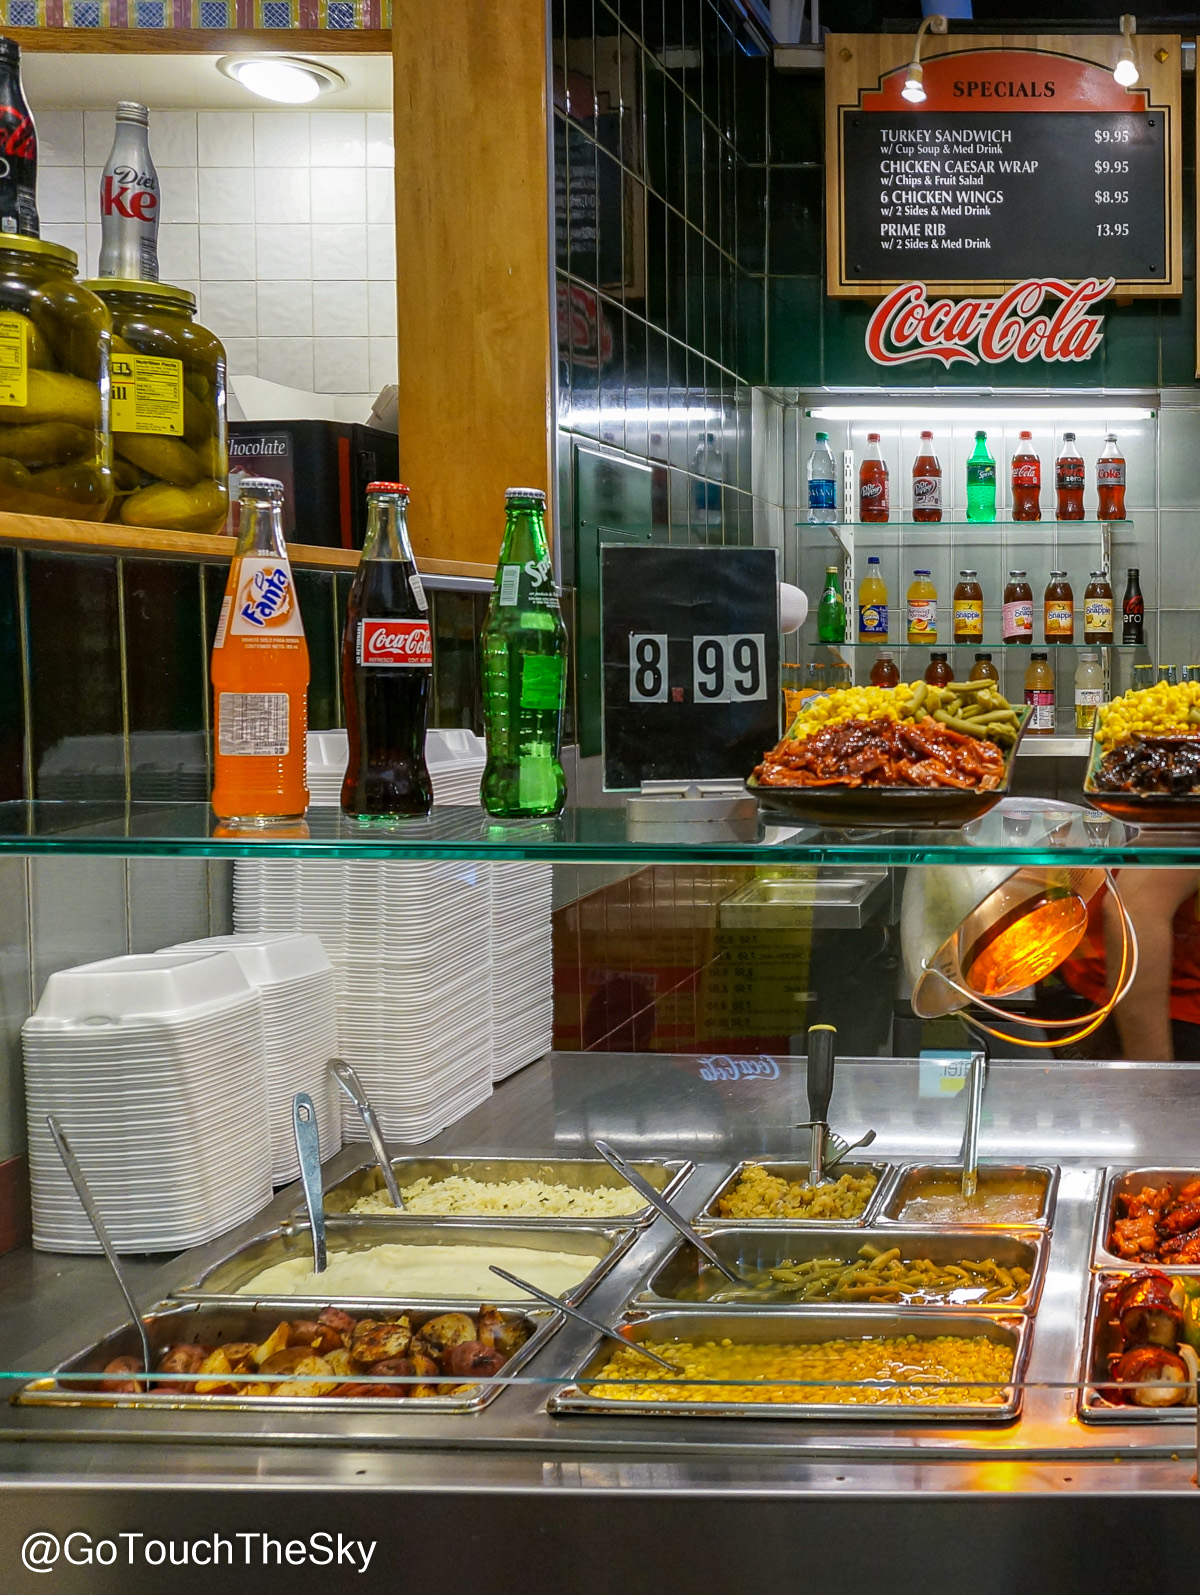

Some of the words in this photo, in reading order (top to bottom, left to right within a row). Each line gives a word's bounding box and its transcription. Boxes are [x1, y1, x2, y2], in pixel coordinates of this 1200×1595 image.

[954, 81, 1055, 98] SPECIALS
[881, 130, 932, 142] TURKEY
[936, 130, 1011, 142] SANDWICH
[1095, 130, 1129, 144] $9.95
[881, 144, 893, 154] w/
[896, 144, 914, 156] Cup
[918, 144, 940, 156] Soup
[943, 144, 950, 154] &
[953, 144, 974, 154] Med
[977, 144, 1003, 154] Drink
[881, 160, 940, 173] CHICKEN
[945, 161, 995, 173] CAESAR
[999, 161, 1038, 173] WRAP
[1095, 161, 1129, 174] $9.95
[881, 175, 894, 186] w/
[896, 175, 922, 186] Chips
[924, 176, 932, 185] &
[935, 175, 956, 185] Fruit
[959, 175, 983, 185] Salad
[881, 191, 888, 203] 6
[892, 191, 952, 204] CHICKEN
[956, 191, 1004, 204] WINGS
[1095, 191, 1128, 204] $8.95
[881, 206, 893, 216] w/
[896, 206, 902, 216] 2
[905, 205, 928, 216] Sides
[931, 206, 938, 216] &
[941, 205, 962, 215] Med
[965, 205, 991, 215] Drink
[881, 224, 920, 236] PRIME
[925, 224, 946, 236] RIB
[1097, 224, 1129, 236] 13.95
[866, 278, 1115, 367] Coca-Cola
[228, 438, 285, 456] hocolate
[1098, 468, 1120, 478] Coke
[240, 568, 289, 626] Fanta
[955, 611, 980, 619] Snapple
[1048, 612, 1072, 620] Snapple
[1086, 607, 1110, 615] Snapple
[1123, 614, 1141, 623] ero
[368, 628, 432, 654] Coca-Cola
